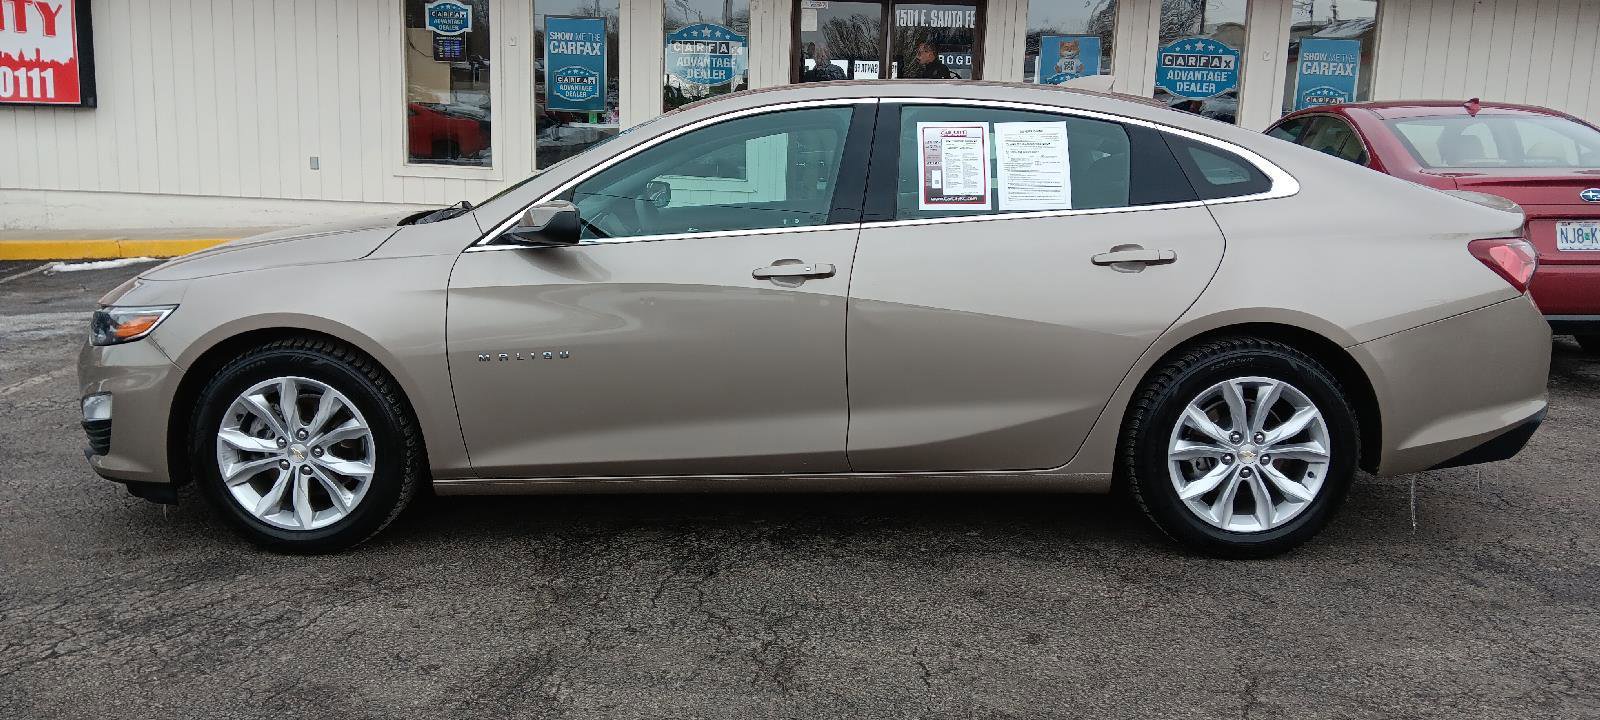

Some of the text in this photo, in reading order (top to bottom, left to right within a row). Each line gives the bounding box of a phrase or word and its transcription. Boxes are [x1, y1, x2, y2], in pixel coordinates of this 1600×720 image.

[896, 9, 918, 27] 1501
[930, 10, 963, 28] SANTA
[965, 10, 976, 28] FE
[549, 31, 600, 41] SHOW ME THE
[549, 41, 601, 56] CARFAX
[672, 41, 742, 55] CARFAX
[677, 56, 736, 68] ADVANTAGE
[1164, 55, 1233, 69] CARFAX
[1303, 52, 1327, 61] SHOW
[1342, 54, 1355, 63] THE
[687, 68, 726, 79] DEALER
[1302, 61, 1354, 77] CARFAX
[1166, 69, 1228, 82] ADVANTAGE
[560, 84, 593, 92] ADVANTAGE
[1176, 81, 1216, 93] DEALER
[1560, 227, 1600, 244] NJ8 K
[478, 350, 570, 362] MALIBU
